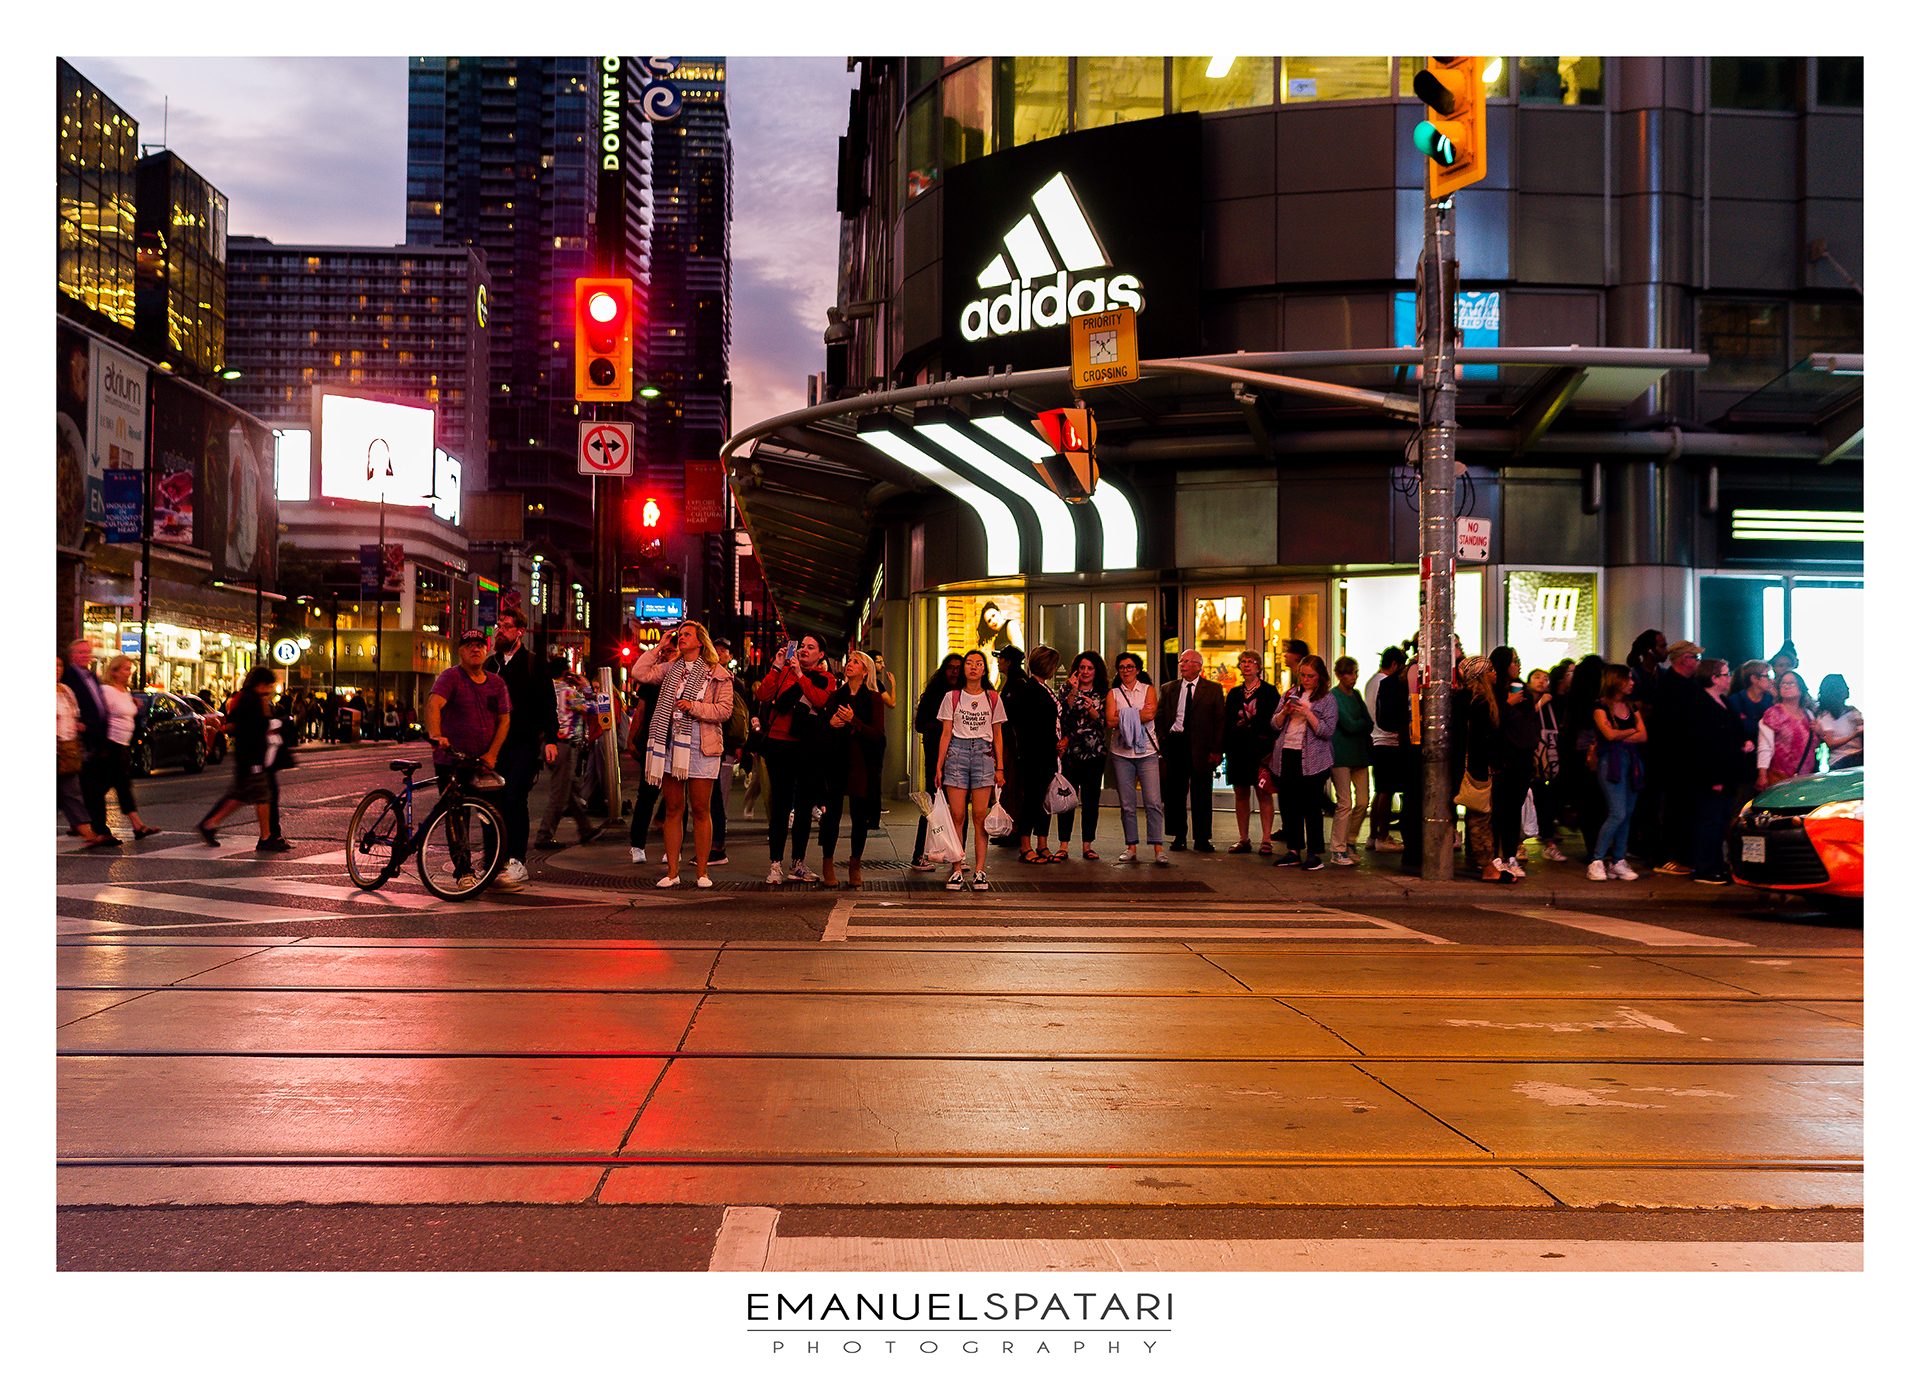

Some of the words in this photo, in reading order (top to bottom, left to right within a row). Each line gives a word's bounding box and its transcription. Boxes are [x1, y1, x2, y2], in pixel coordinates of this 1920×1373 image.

[960, 270, 1146, 342] adidas
[1083, 314, 1122, 330] PRIORITY
[1083, 366, 1128, 383] CROSSING
[104, 361, 141, 405] atrium
[1467, 522, 1479, 533] NO
[1459, 534, 1487, 547] STANDING
